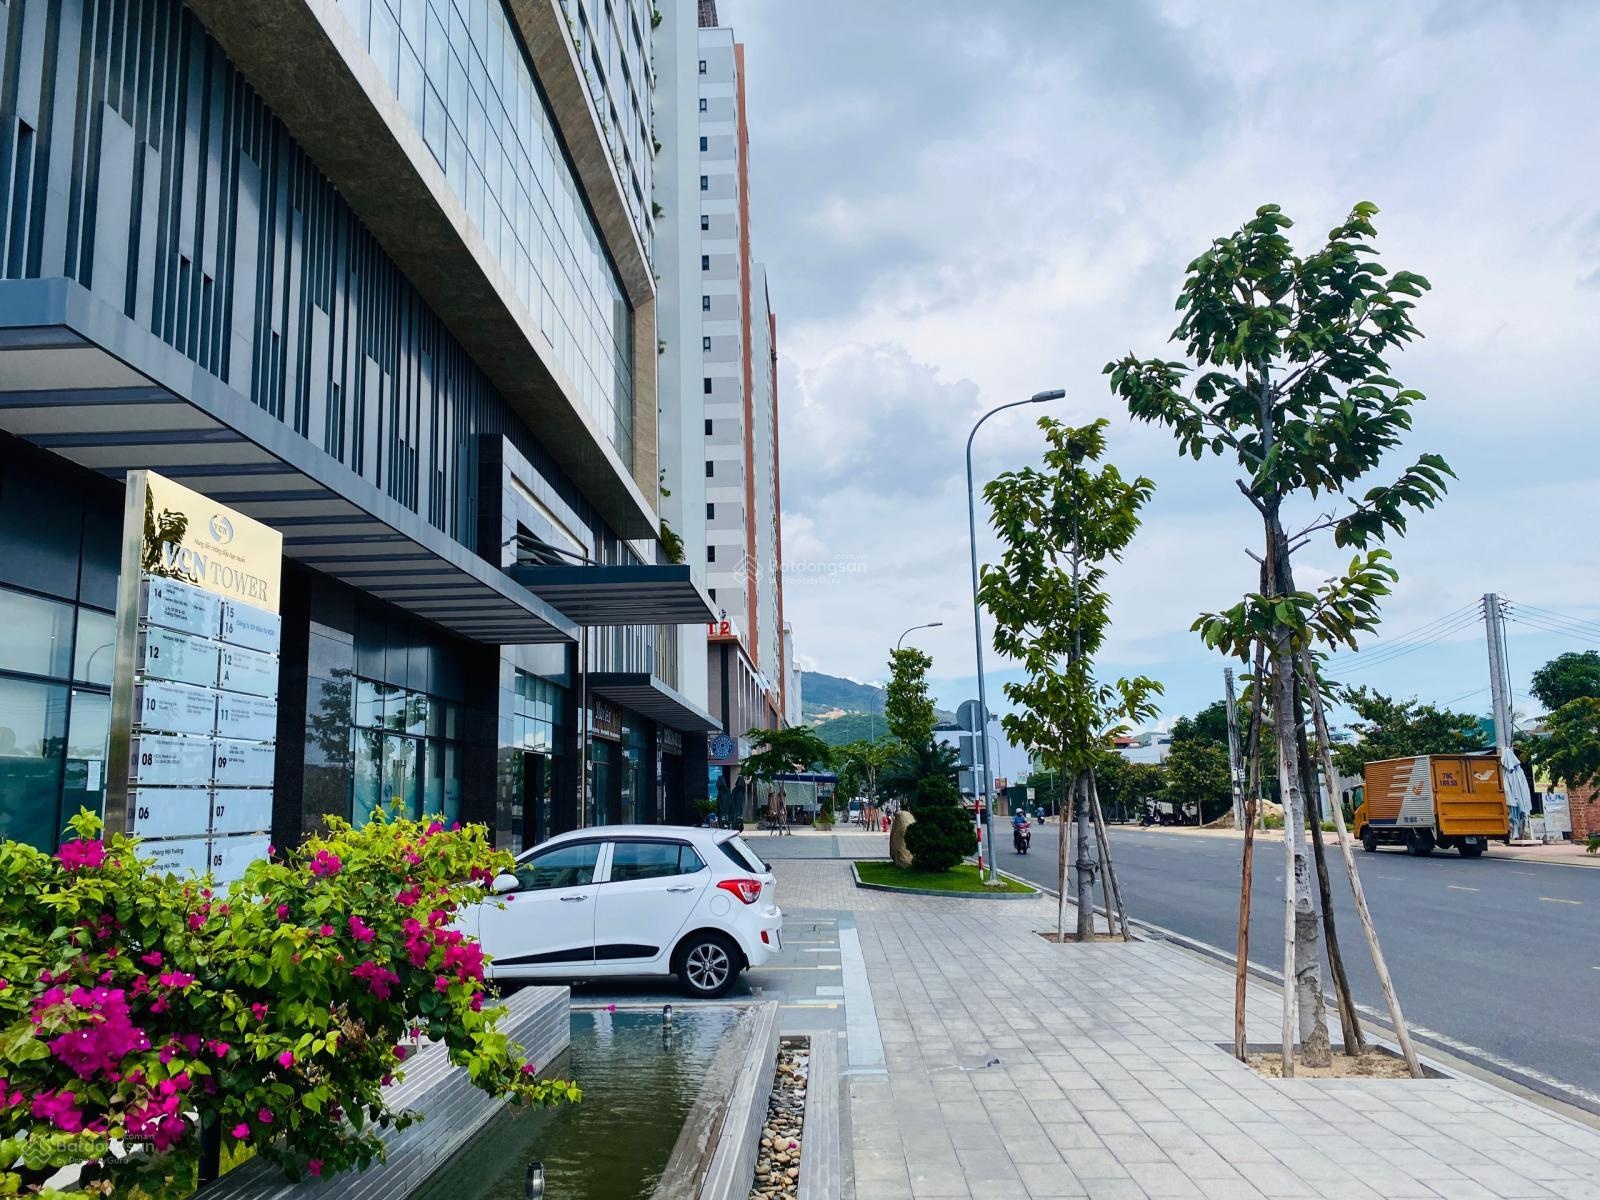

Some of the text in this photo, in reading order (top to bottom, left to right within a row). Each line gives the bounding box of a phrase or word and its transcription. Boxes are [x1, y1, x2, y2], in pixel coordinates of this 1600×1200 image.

[162, 540, 208, 581] VCN
[210, 561, 268, 602] TOWER
[154, 588, 162, 599] 14
[226, 605, 234, 618] 15
[225, 622, 234, 634] 16
[149, 645, 159, 659] 12
[224, 653, 232, 666] 12
[224, 670, 230, 681] A
[146, 697, 156, 711] 10
[221, 709, 229, 721] 11
[142, 753, 153, 766] 08
[218, 757, 227, 768] 09
[138, 807, 149, 819] 06
[216, 806, 225, 817] 07
[213, 855, 223, 867] 05
